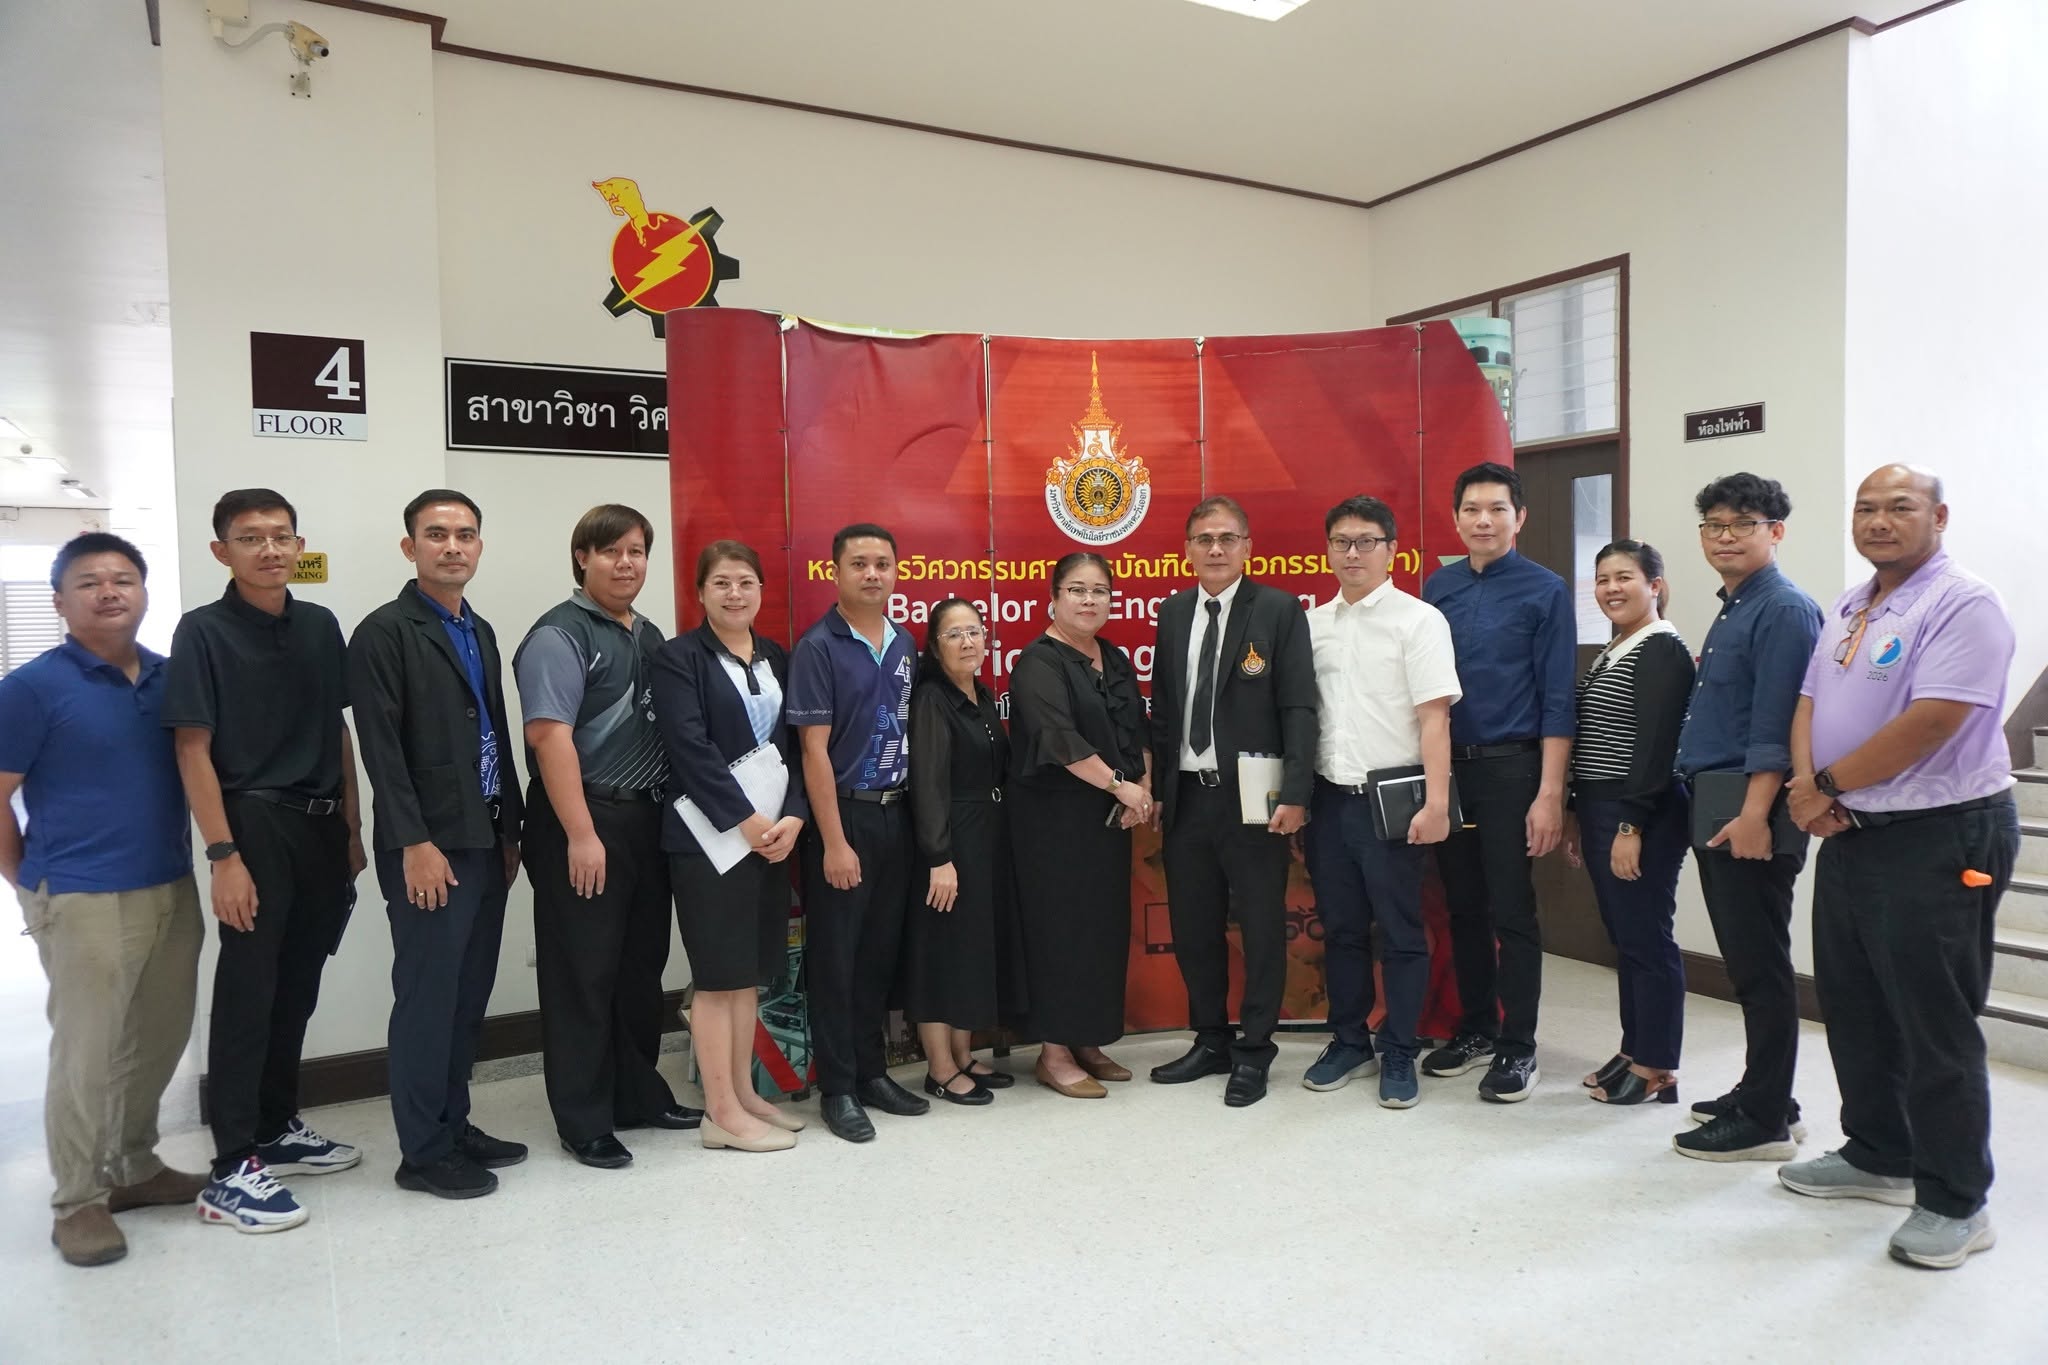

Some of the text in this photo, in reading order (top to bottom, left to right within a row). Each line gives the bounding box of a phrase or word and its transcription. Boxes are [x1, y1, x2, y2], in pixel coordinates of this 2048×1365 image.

[315, 346, 360, 401] 4
[259, 413, 344, 436] FLOOR
[467, 389, 669, 431] สาขาวิชา วิศ
[1697, 410, 1751, 437] ห้องไฟฟ้า
[887, 592, 1037, 624] Baelor
